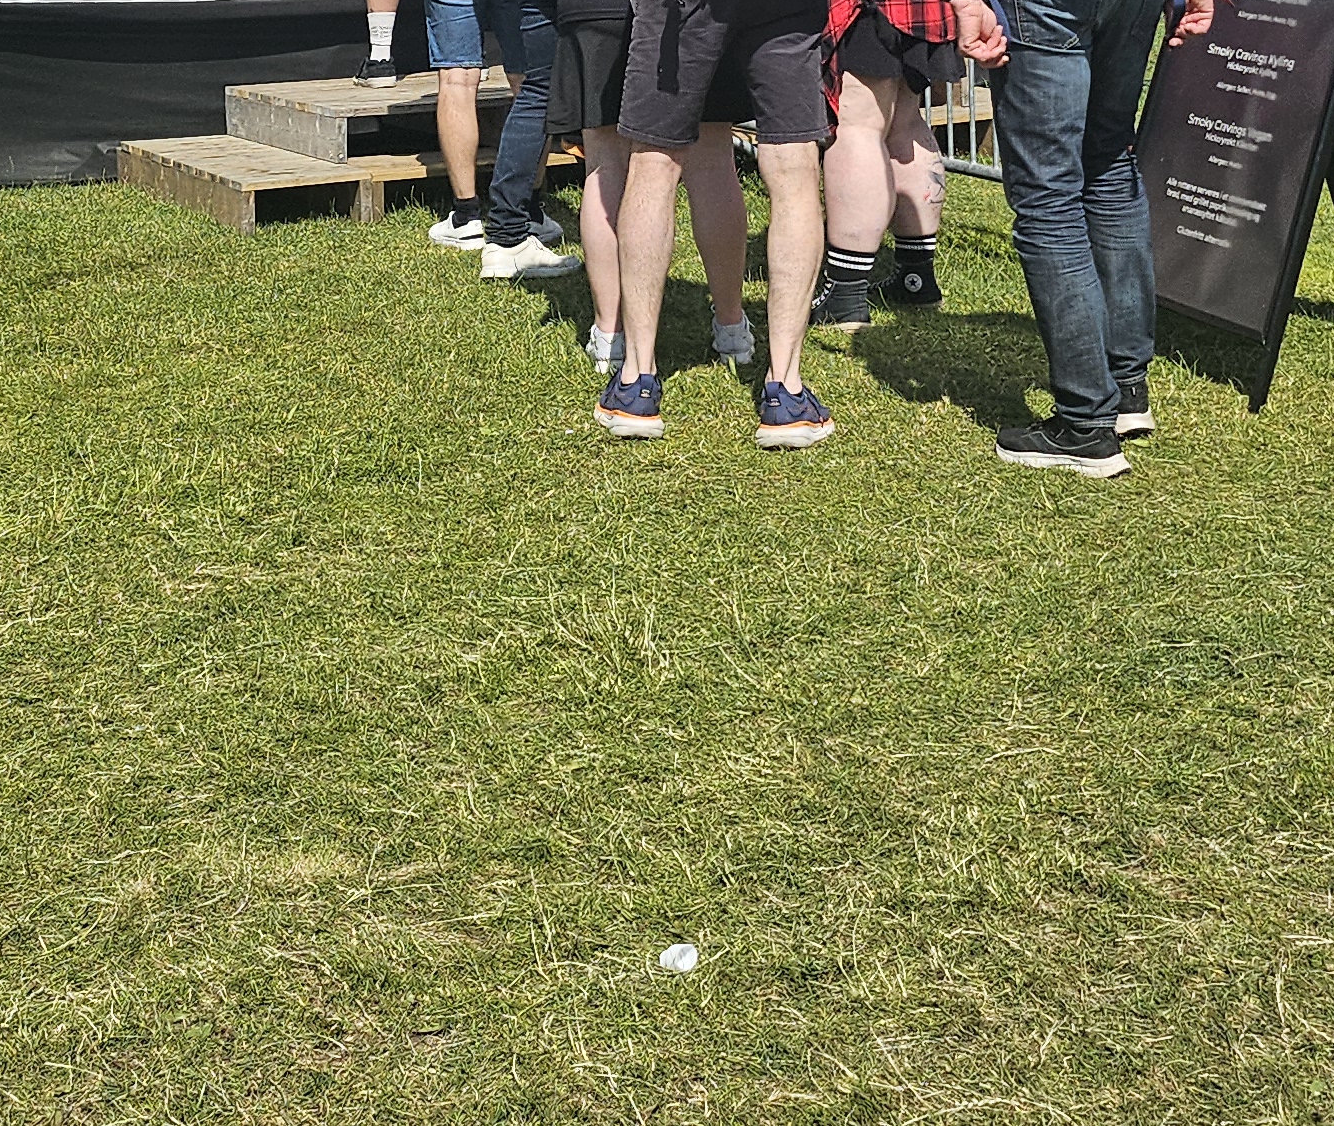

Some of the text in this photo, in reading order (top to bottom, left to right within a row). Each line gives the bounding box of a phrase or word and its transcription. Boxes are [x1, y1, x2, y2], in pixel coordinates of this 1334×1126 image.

[1207, 42, 1235, 60] Smoky
[1235, 48, 1268, 65] Cravings
[1187, 112, 1214, 131] Smoky
[1214, 119, 1246, 138] Cravings
